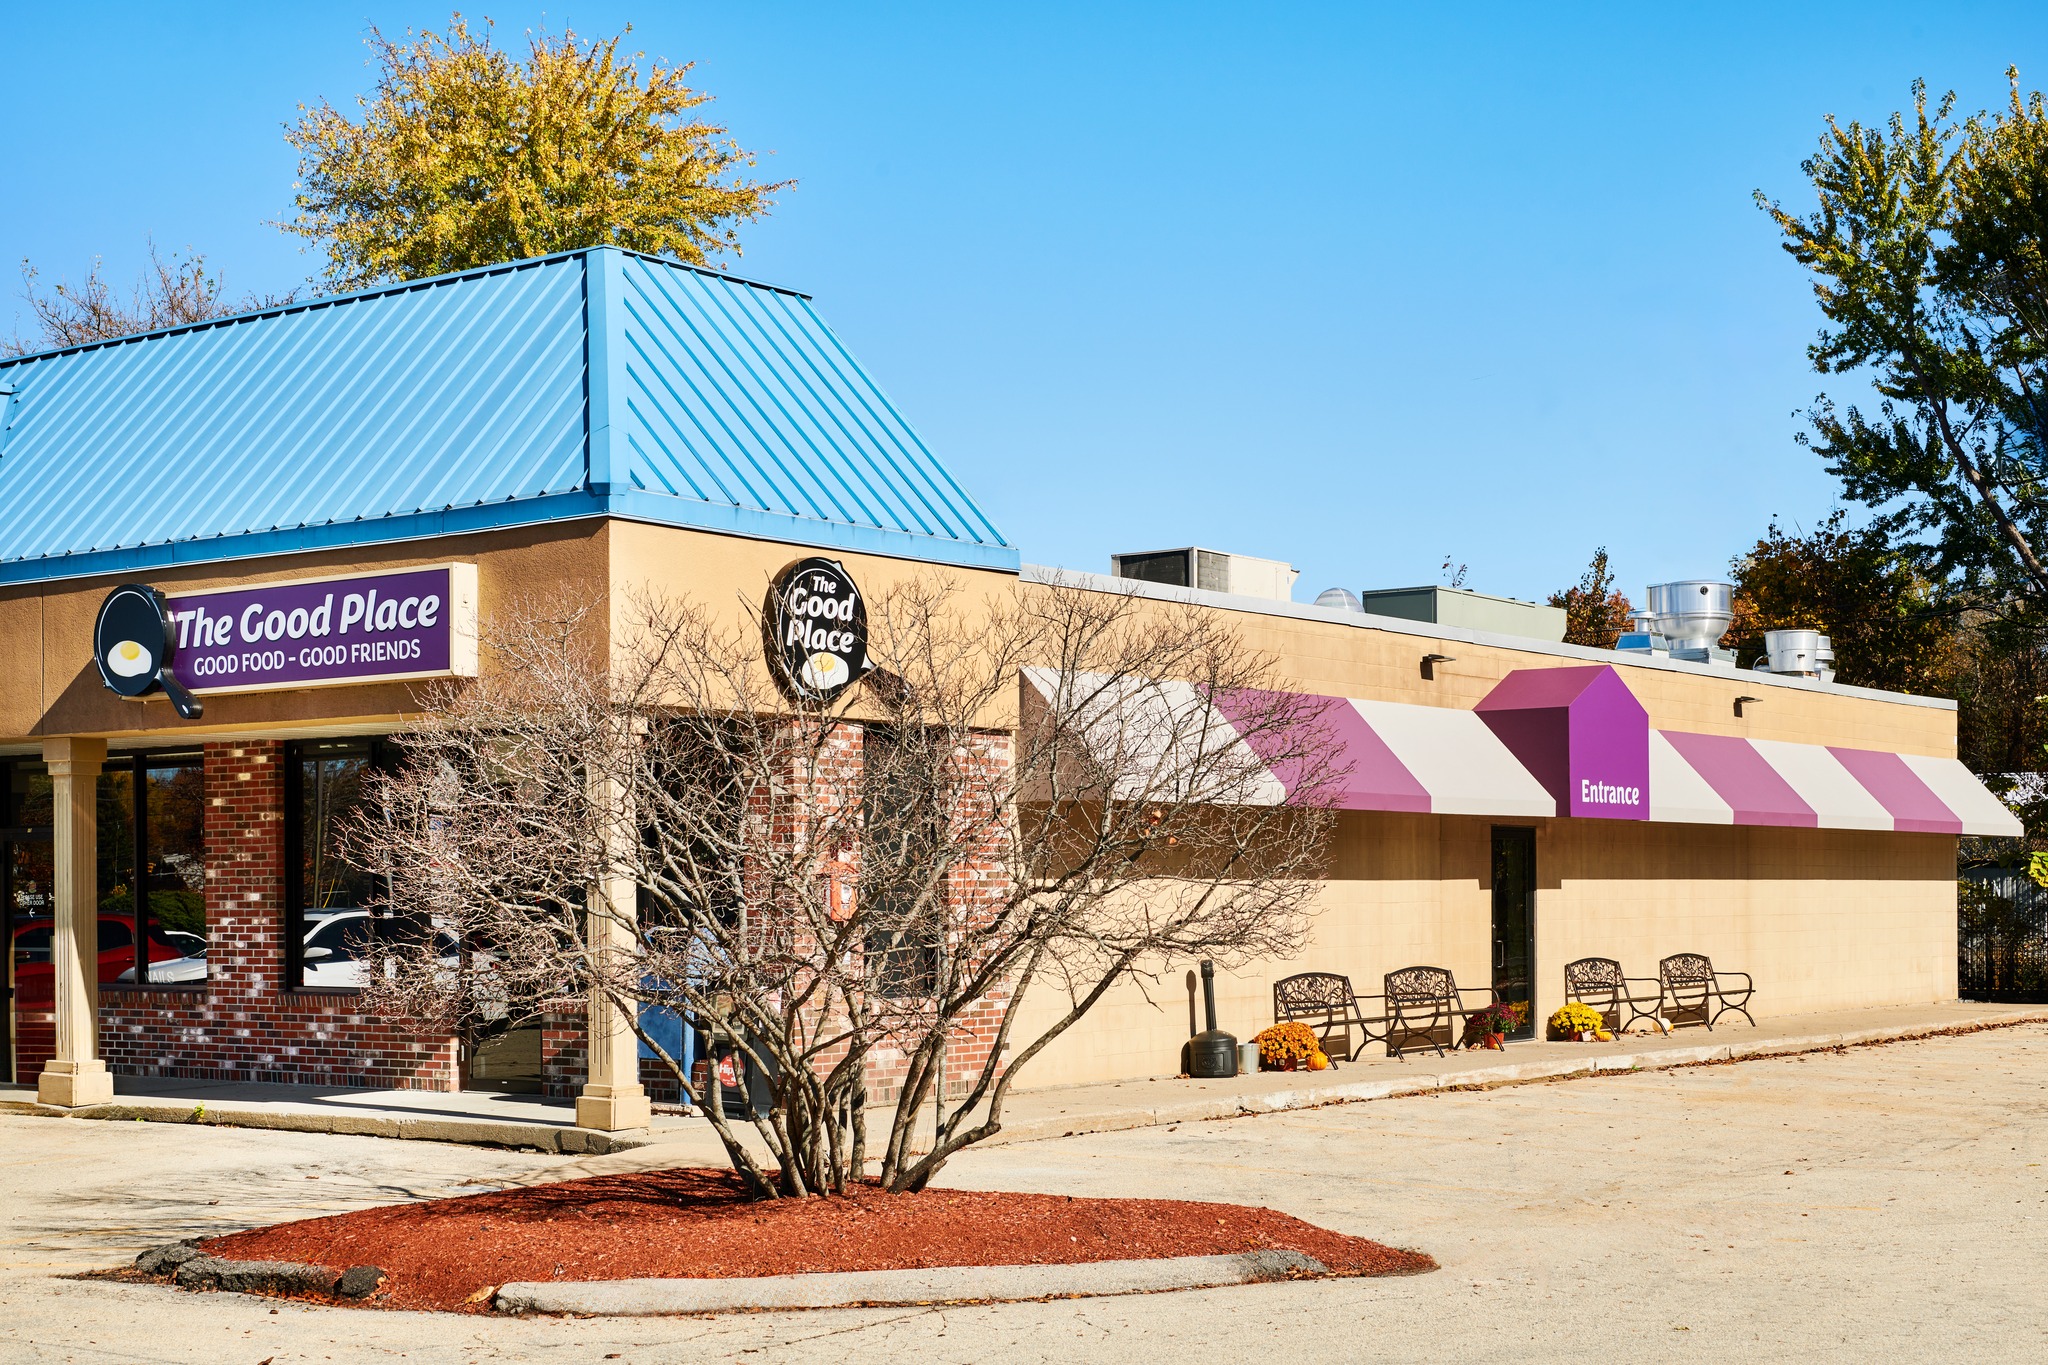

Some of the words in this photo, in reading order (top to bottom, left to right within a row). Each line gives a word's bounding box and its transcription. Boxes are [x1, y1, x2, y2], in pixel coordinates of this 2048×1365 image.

[813, 575, 837, 594] The
[176, 606, 234, 649] The
[240, 593, 334, 644] Good
[339, 589, 440, 634] Place
[789, 587, 856, 621] Good
[786, 619, 855, 653] Place
[194, 654, 239, 676] GOOD
[242, 650, 285, 672] FOOD
[299, 645, 347, 668] GOOD
[351, 638, 421, 663] FRIENDS
[1581, 779, 1640, 806] Entrance
[144, 970, 175, 985] NAILS
